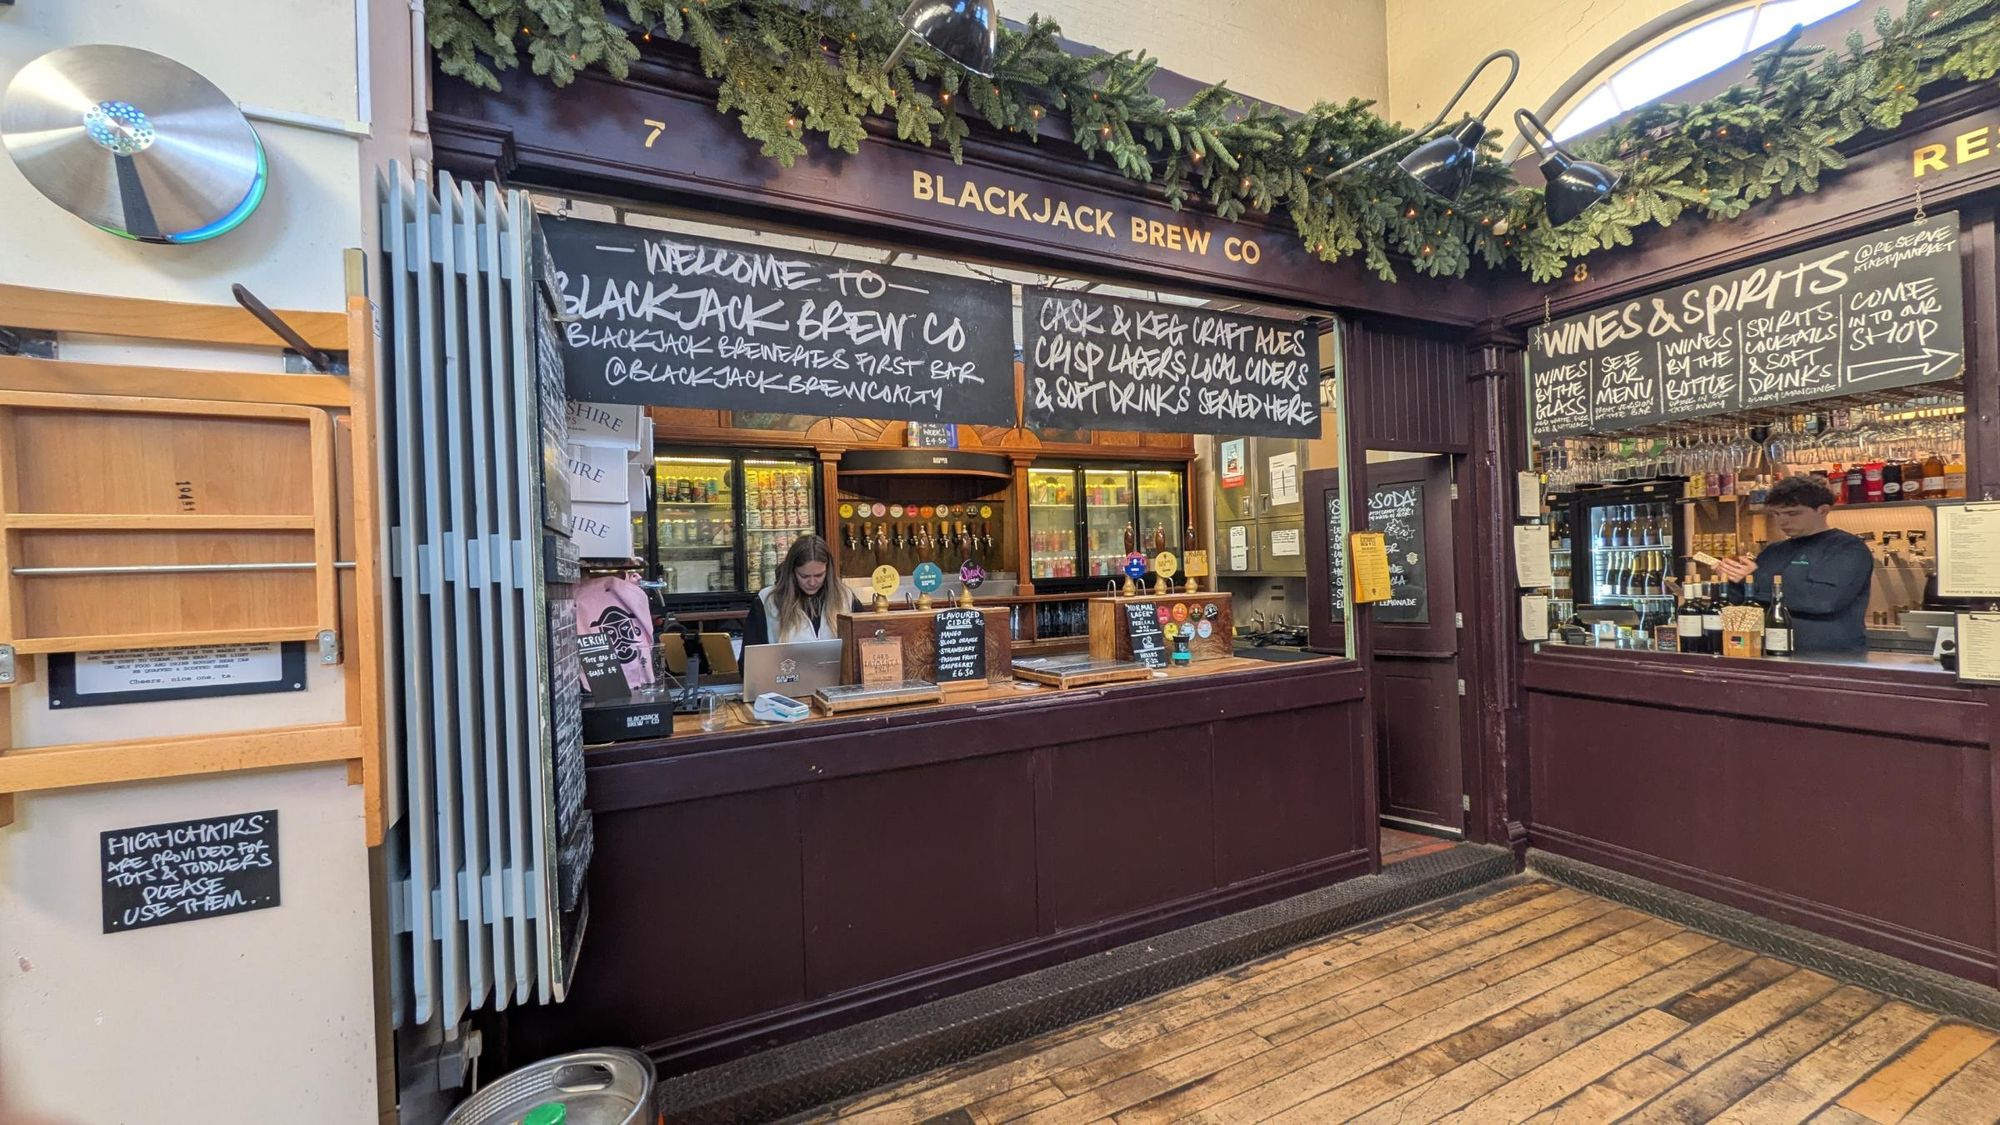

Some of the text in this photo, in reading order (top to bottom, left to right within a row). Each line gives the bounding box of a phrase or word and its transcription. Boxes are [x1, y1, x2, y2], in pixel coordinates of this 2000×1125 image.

[644, 119, 665, 148] 7
[1912, 126, 2000, 178] RE
[912, 169, 1260, 265] BLACKJACK BREW CO
[643, 239, 886, 298] WELCOME TO
[1574, 263, 1588, 282] 8
[1543, 250, 1849, 358] WINES & SPIRITS
[1850, 277, 1938, 311] COME
[556, 271, 966, 352] BLACKJACK BREW CO
[1040, 297, 1305, 357] CASK & KEG CRAFT ALES
[1848, 296, 1942, 329] IN TO OUR
[1665, 327, 1733, 357] WINES
[1745, 323, 1838, 354] COCKTAILS
[1850, 319, 1938, 351] SHOP
[568, 322, 713, 359] BLACKJACK
[855, 352, 926, 376] FIRST
[930, 360, 985, 384] BAR
[1034, 333, 1104, 381] CRISP
[1190, 353, 1242, 385] LOCAL
[1245, 357, 1309, 392] CIDERS
[1601, 350, 1644, 373] SEE
[1666, 350, 1736, 378] BY THE
[1748, 346, 1827, 377] & SOFT
[1534, 360, 1588, 388] WINES
[1602, 367, 1645, 389] OUR
[1666, 374, 1738, 401] BOTTLE
[1748, 363, 1833, 396] DRINKS
[1034, 376, 1318, 426] & SOFT DRINKS SERVED HERE
[1535, 381, 1586, 403] BY THE
[1596, 378, 1653, 406] MENU
[1536, 396, 1587, 420] GLASS
[1371, 490, 1418, 508] SODA
[936, 611, 980, 622] FLAVOURED
[1380, 598, 1417, 607] LEMONADE
[947, 619, 972, 627] CIDER
[108, 815, 265, 856] HIGHCHAIRS
[107, 853, 273, 888] TOTS & TODDLERS
[108, 839, 269, 873] ARE PROVIDED FOR
[142, 877, 227, 905] PLEASE
[123, 902, 178, 926] USE
